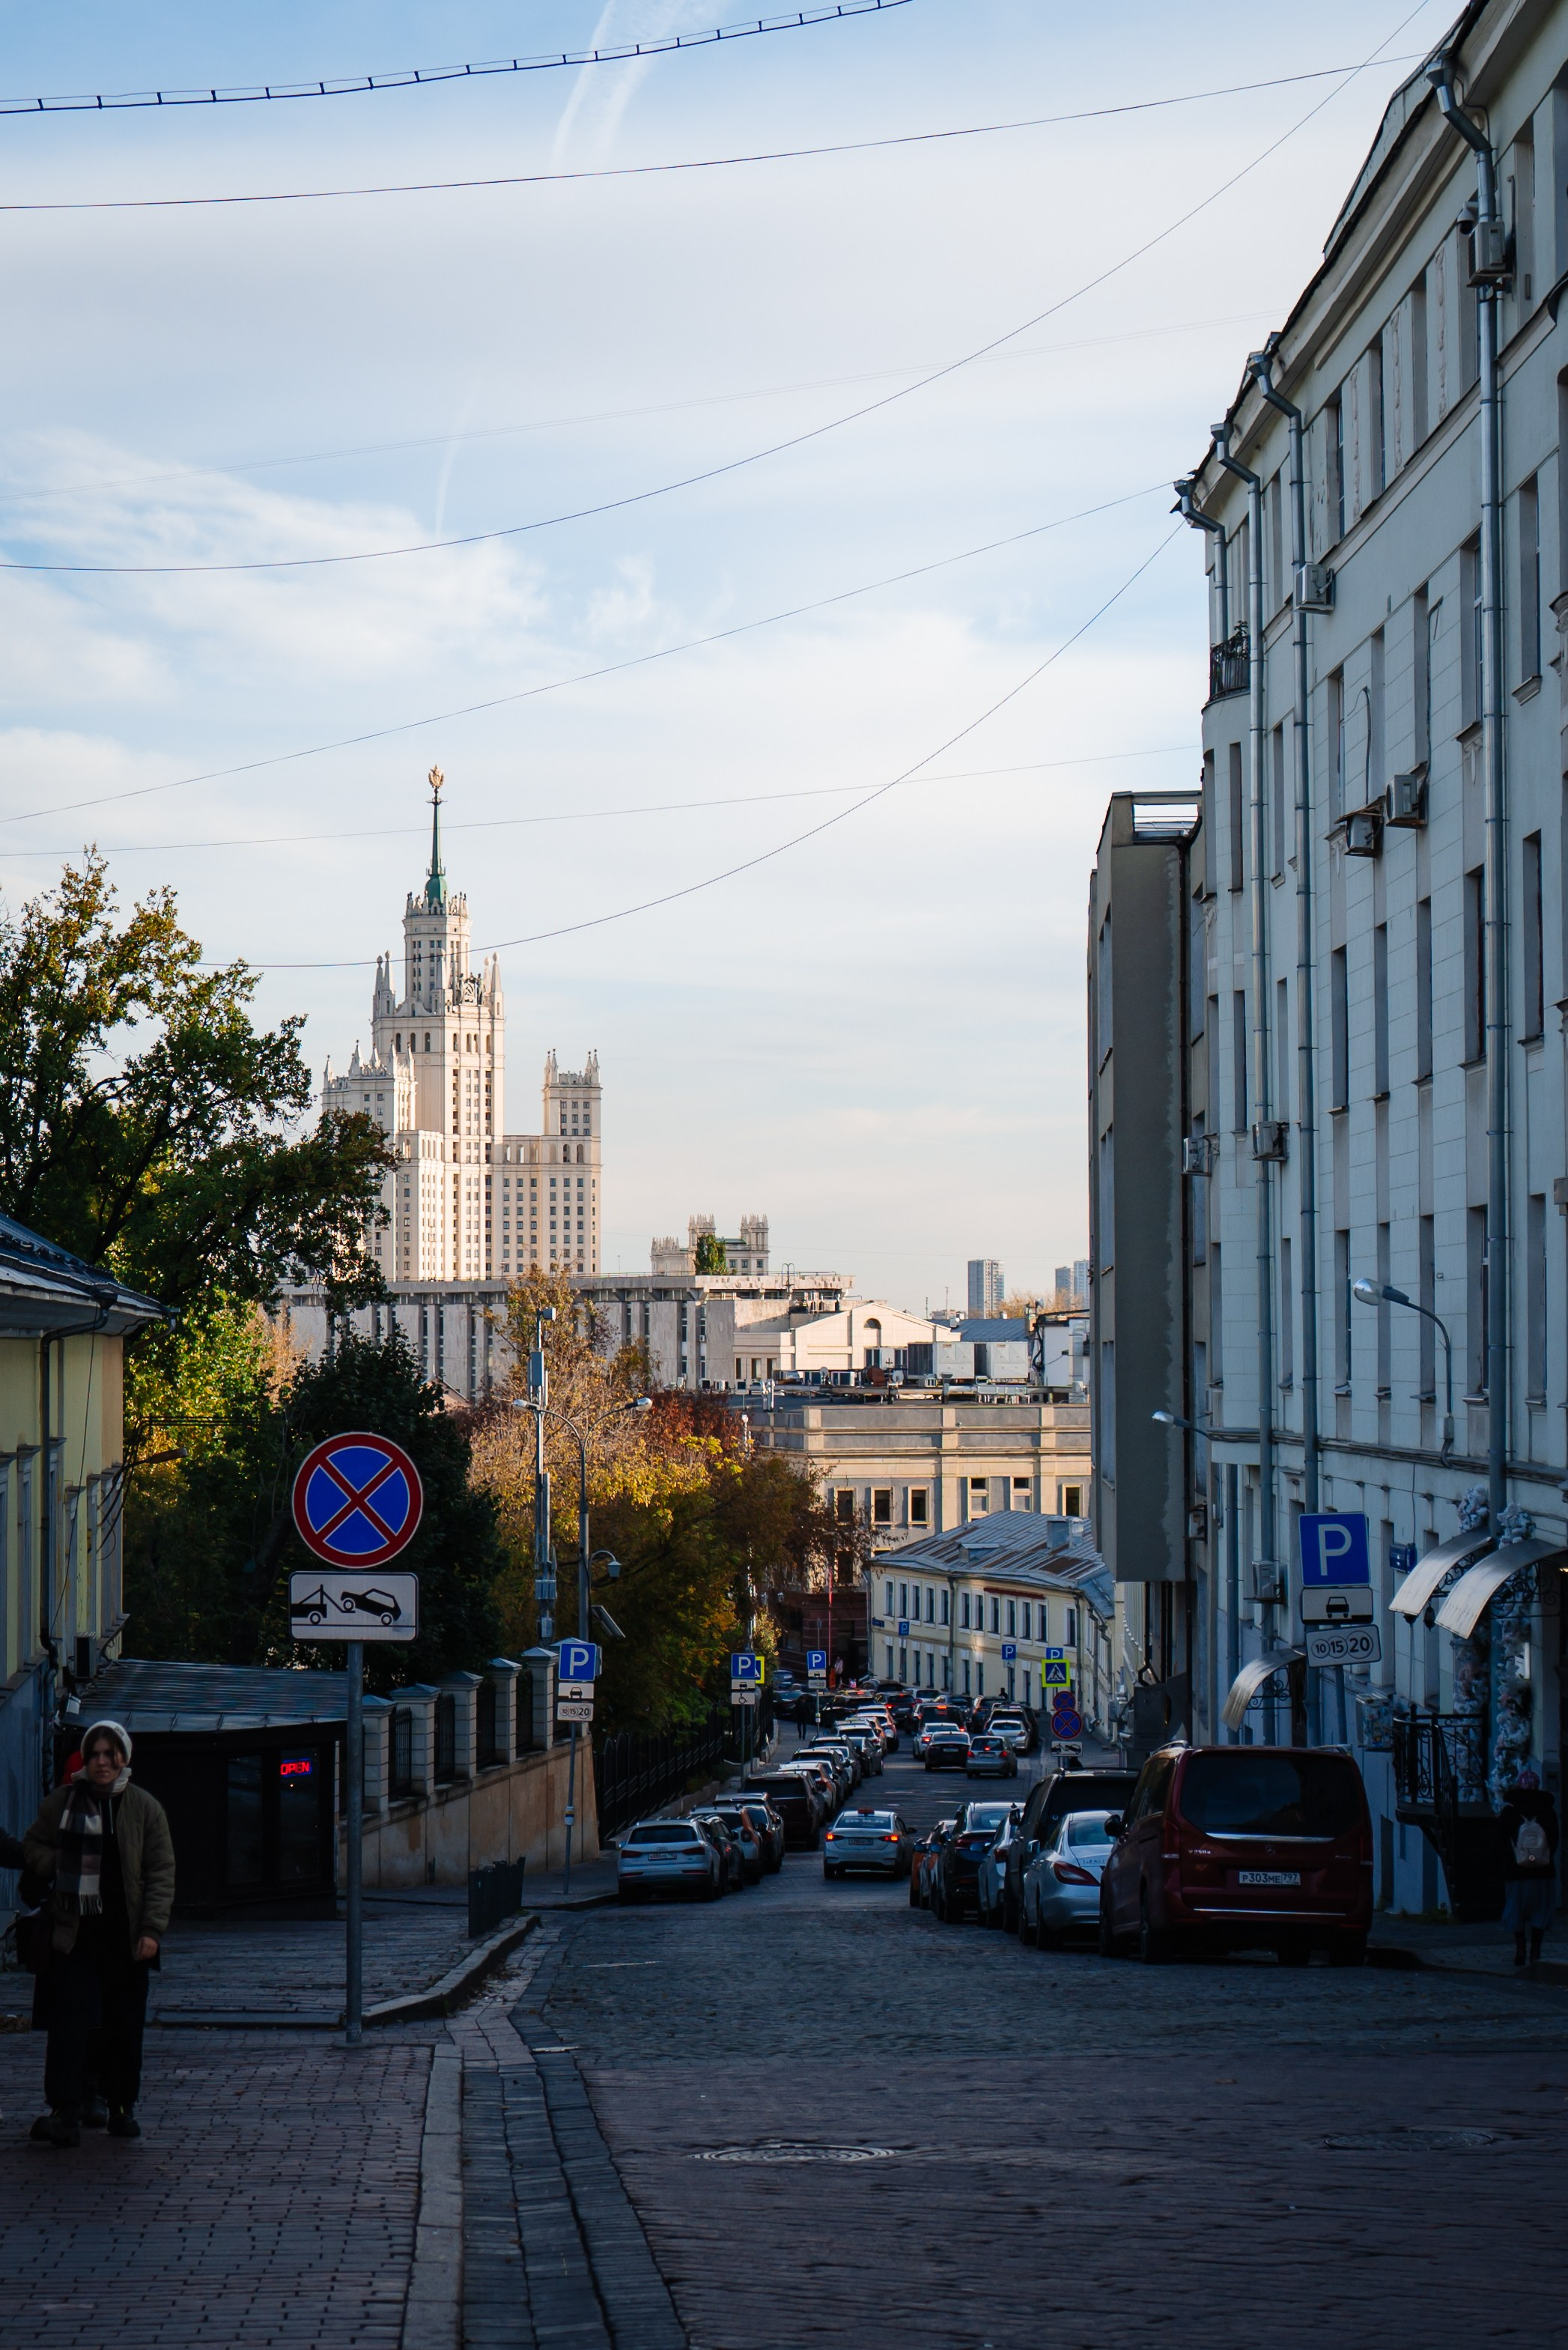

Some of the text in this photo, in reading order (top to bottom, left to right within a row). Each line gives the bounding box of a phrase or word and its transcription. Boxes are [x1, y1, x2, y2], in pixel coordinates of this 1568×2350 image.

[1318, 1523, 1352, 1576] P
[901, 1623, 908, 1634] P
[1006, 1645, 1014, 1658] P
[1316, 1636, 1370, 1654] 10 15 20
[569, 1647, 589, 1676] P
[812, 1654, 822, 1668] P
[1051, 1649, 1060, 1660] P
[738, 1656, 751, 1675] P
[578, 1707, 589, 1716] 20
[281, 1761, 310, 1776] OPEN
[1281, 1873, 1297, 1882] 797
